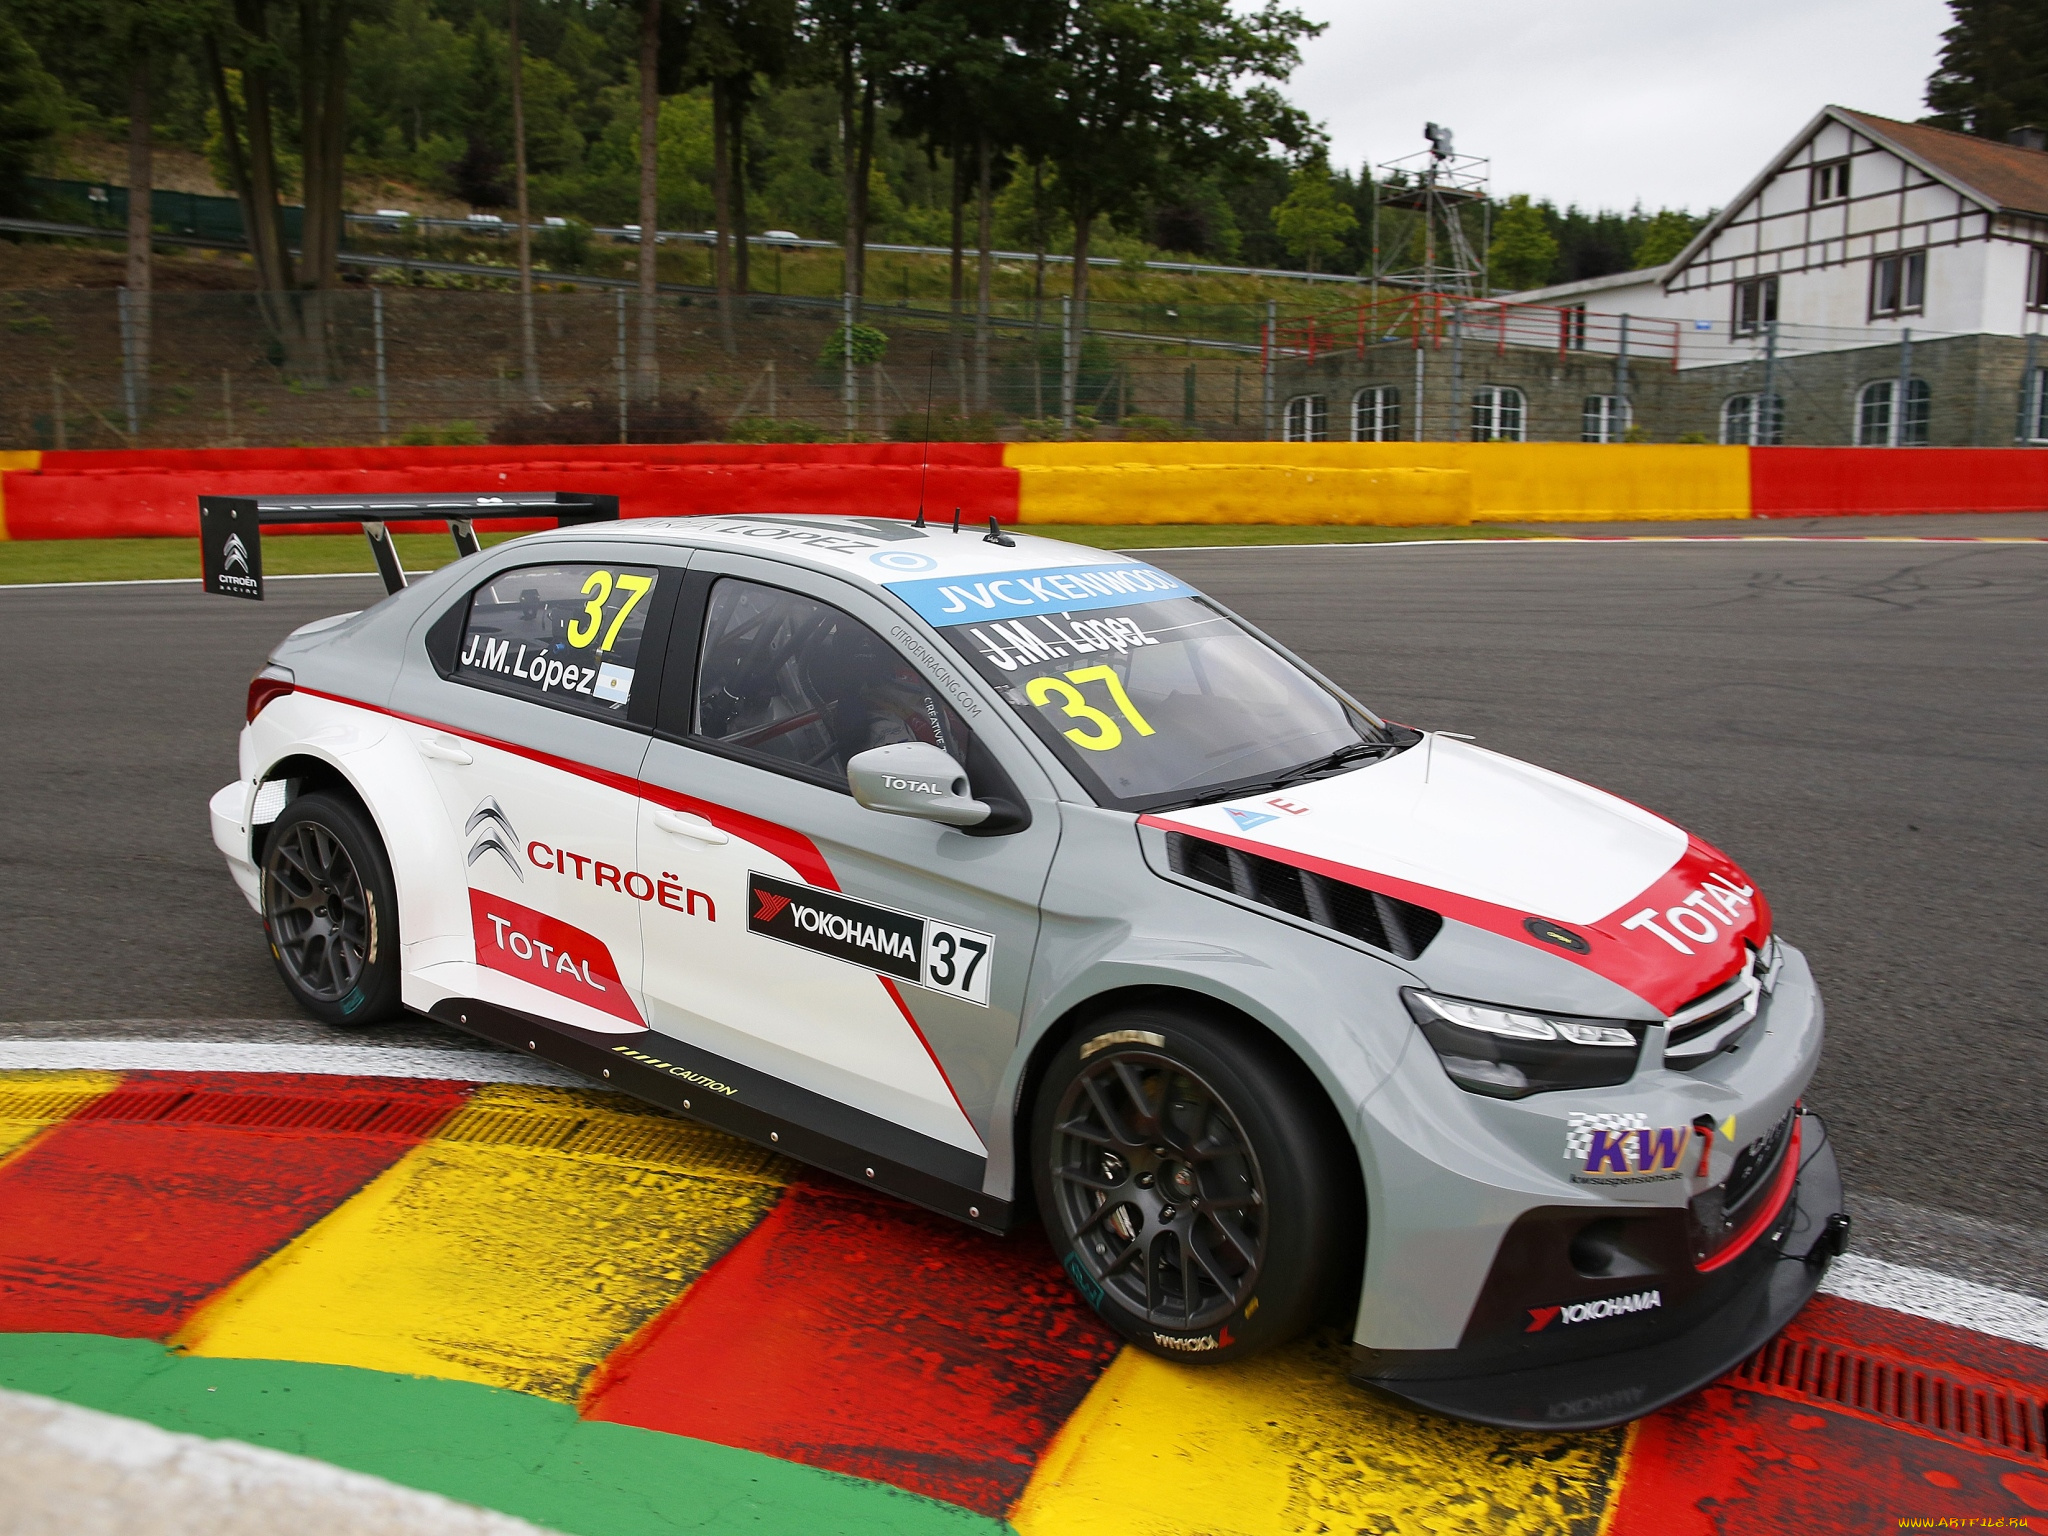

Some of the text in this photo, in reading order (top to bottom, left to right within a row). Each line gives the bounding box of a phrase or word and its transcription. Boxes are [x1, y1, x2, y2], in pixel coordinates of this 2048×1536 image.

[567, 570, 653, 652] 37
[890, 624, 982, 719] CITROENRACING.COM
[1025, 664, 1156, 751] 37
[881, 774, 943, 795] TOTAL
[527, 840, 716, 923] CITROËN
[790, 902, 917, 963] YOKOHAMA
[1620, 871, 1755, 956] TOTAL
[487, 912, 607, 992] TOTAL
[930, 930, 988, 992] 37
[669, 1066, 738, 1096] CAUTION
[1582, 1124, 1692, 1175] KW
[1560, 1290, 1661, 1324] YOKOHAMA
[1153, 1331, 1219, 1352] YOKOHAMA
